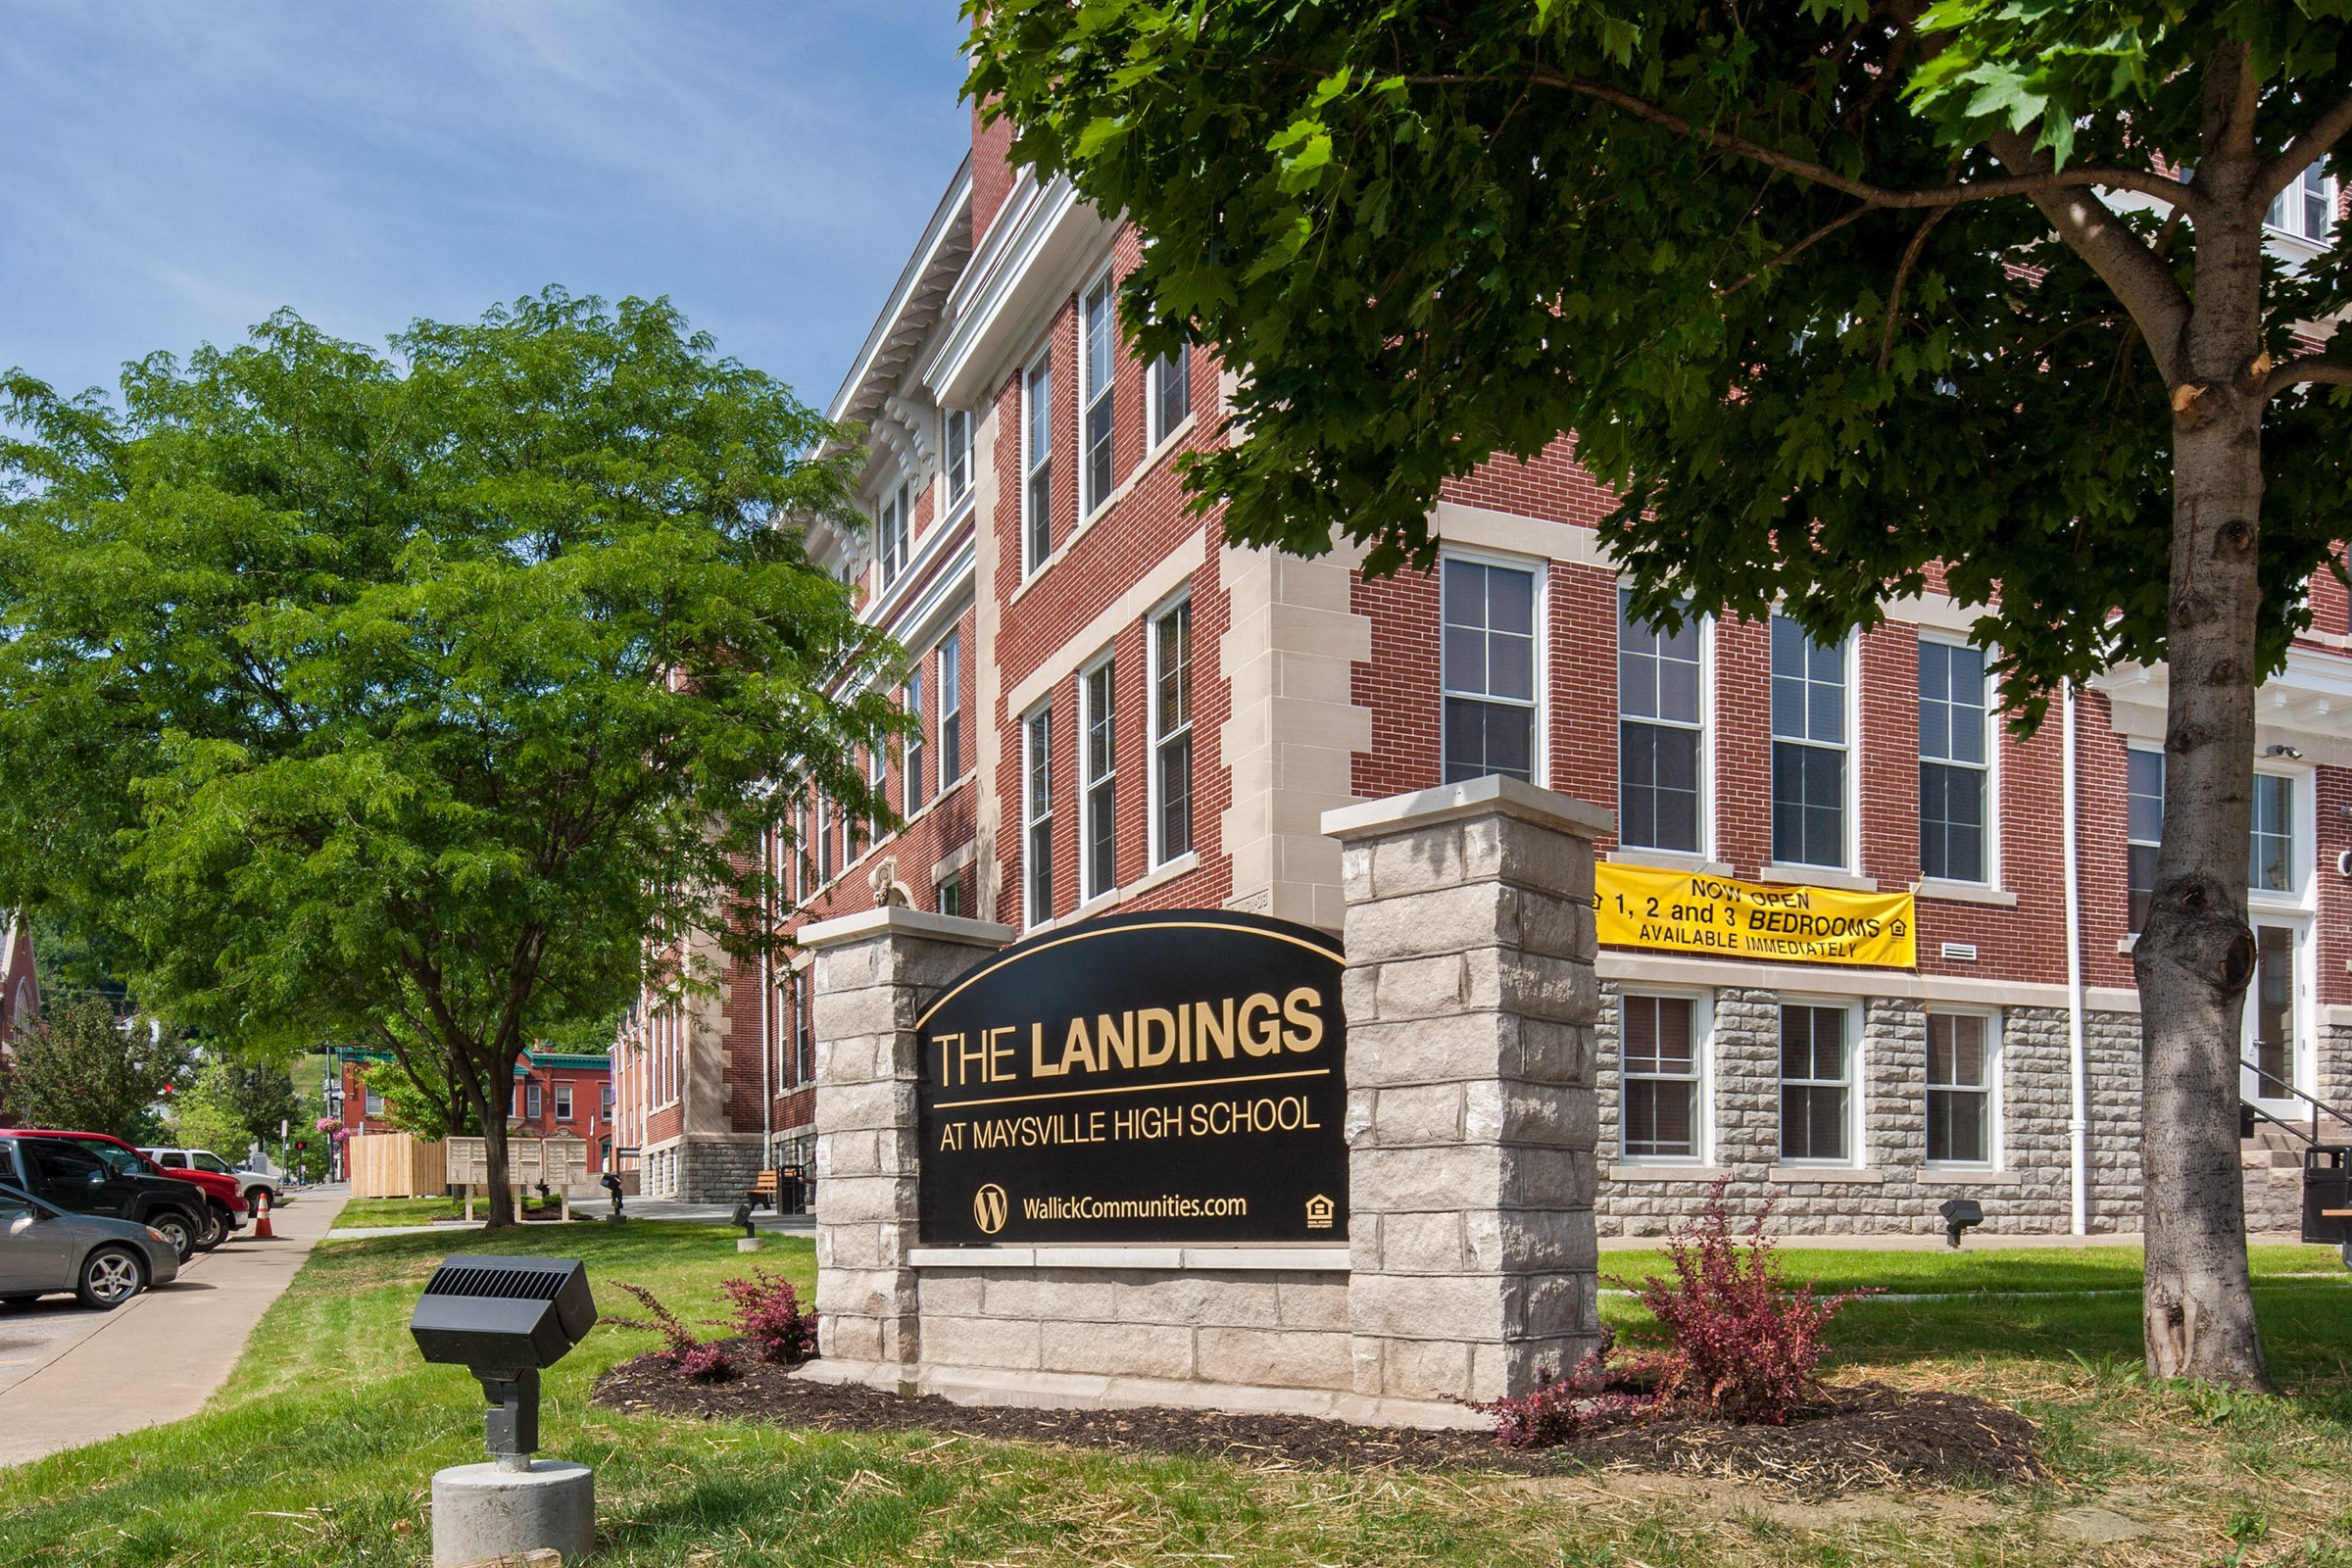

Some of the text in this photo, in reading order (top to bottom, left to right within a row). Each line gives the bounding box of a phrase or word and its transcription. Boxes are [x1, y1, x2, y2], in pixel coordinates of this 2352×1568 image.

[1691, 878, 1810, 910] NOW OPEN
[1615, 893, 1881, 939] 1, 2 and 3 BEDROOMS
[1639, 924, 1857, 959] AVAILABLE IMMEDIATELY
[931, 986, 1324, 1088] THE LANDINGS
[940, 1096, 1321, 1152] AT MAYSVILLE HIGH SCHOOL
[1022, 1194, 1248, 1220] WallickCommunities.com
